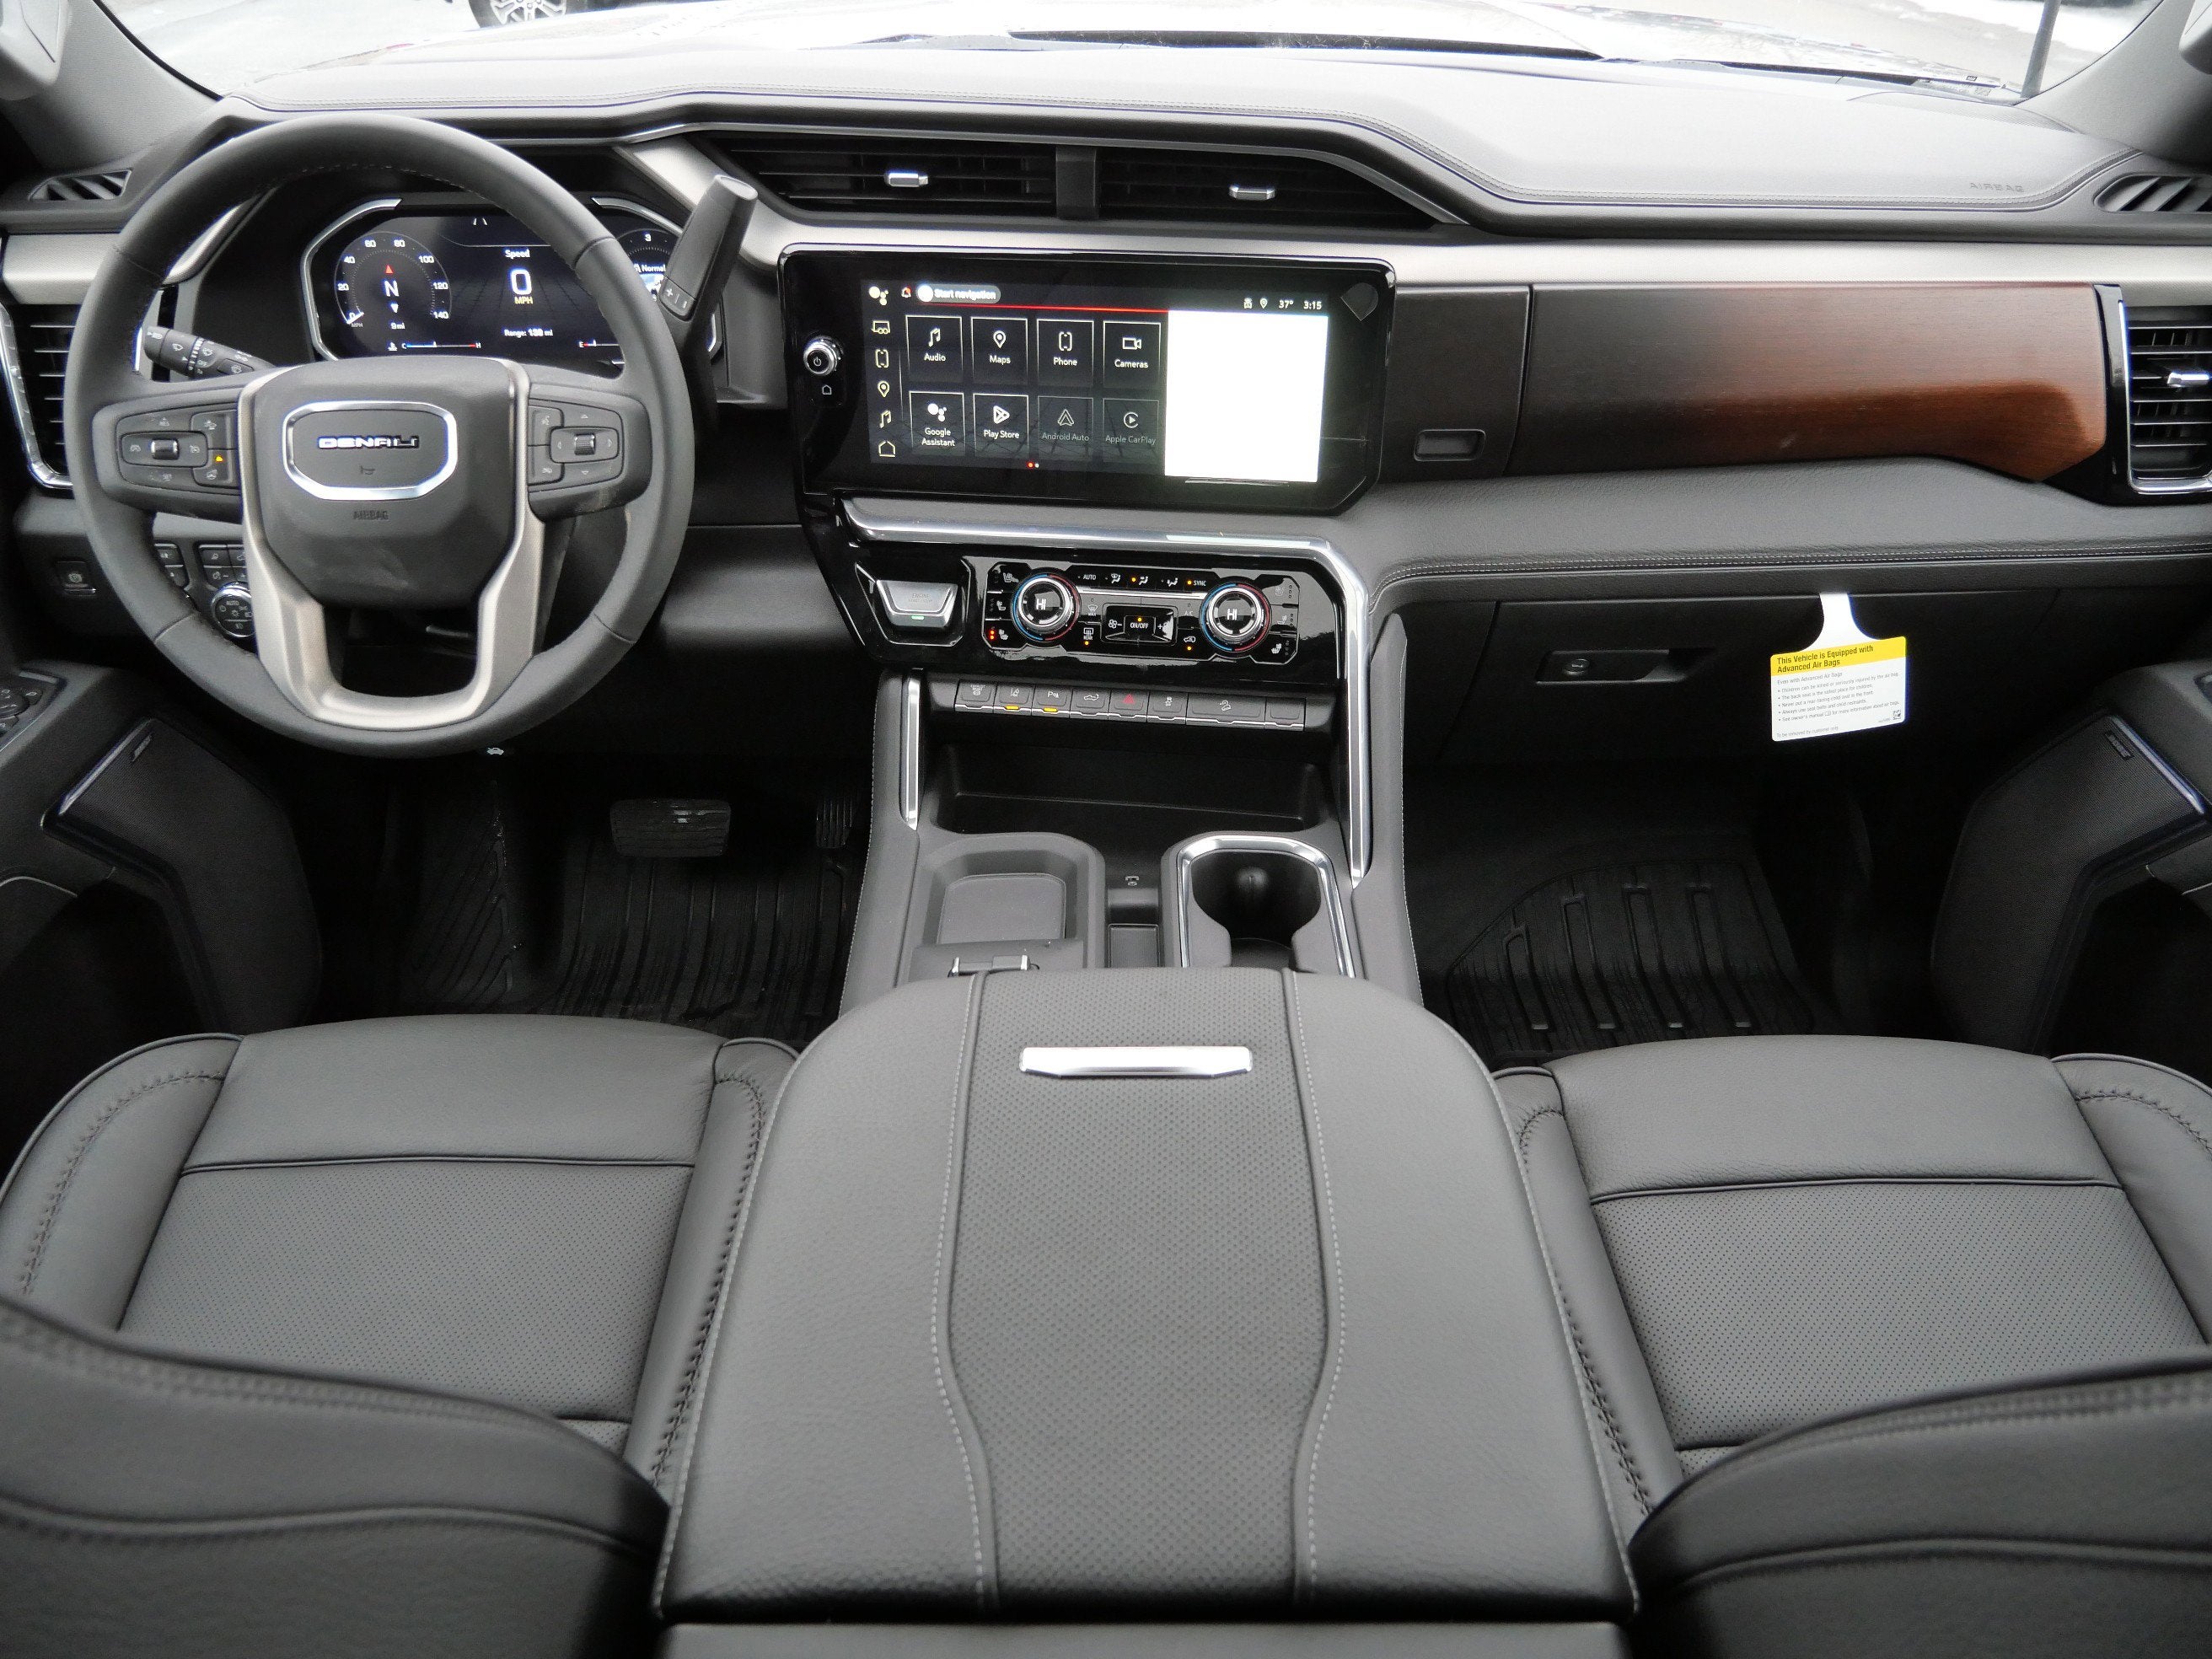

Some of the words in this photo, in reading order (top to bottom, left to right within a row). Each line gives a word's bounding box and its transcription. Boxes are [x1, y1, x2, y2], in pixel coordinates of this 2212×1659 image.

[1970, 182, 2024, 192] AIRBAG
[344, 255, 355, 264] 40
[505, 250, 530, 259] Speed
[511, 269, 532, 295] 0
[384, 280, 400, 297] N
[514, 296, 533, 304] MPH
[934, 289, 954, 298] Start
[954, 290, 996, 301] navigation
[1303, 301, 1322, 309] 3:15
[504, 329, 527, 338] Range:
[924, 352, 946, 362] Audio
[989, 355, 1011, 365] Maps
[1054, 357, 1077, 367] Phone
[1114, 359, 1148, 368] Cameras
[925, 427, 951, 438] Google
[984, 429, 999, 439] Play
[1000, 430, 1020, 439] Store
[1042, 432, 1071, 441] Android
[1071, 433, 1089, 442] Auto
[318, 435, 420, 449] DENALI
[921, 438, 955, 448] Assistant
[1105, 435, 1126, 444] Apple
[1128, 435, 1157, 446] CarPlay
[353, 510, 389, 520] AIRBAG
[1036, 598, 1047, 610] HI
[1227, 609, 1238, 620] HI
[1793, 653, 1818, 663] Vehicle
[1827, 647, 1857, 658] Equipped
[1859, 645, 1873, 653] with
[1777, 662, 1811, 673] Advanced
